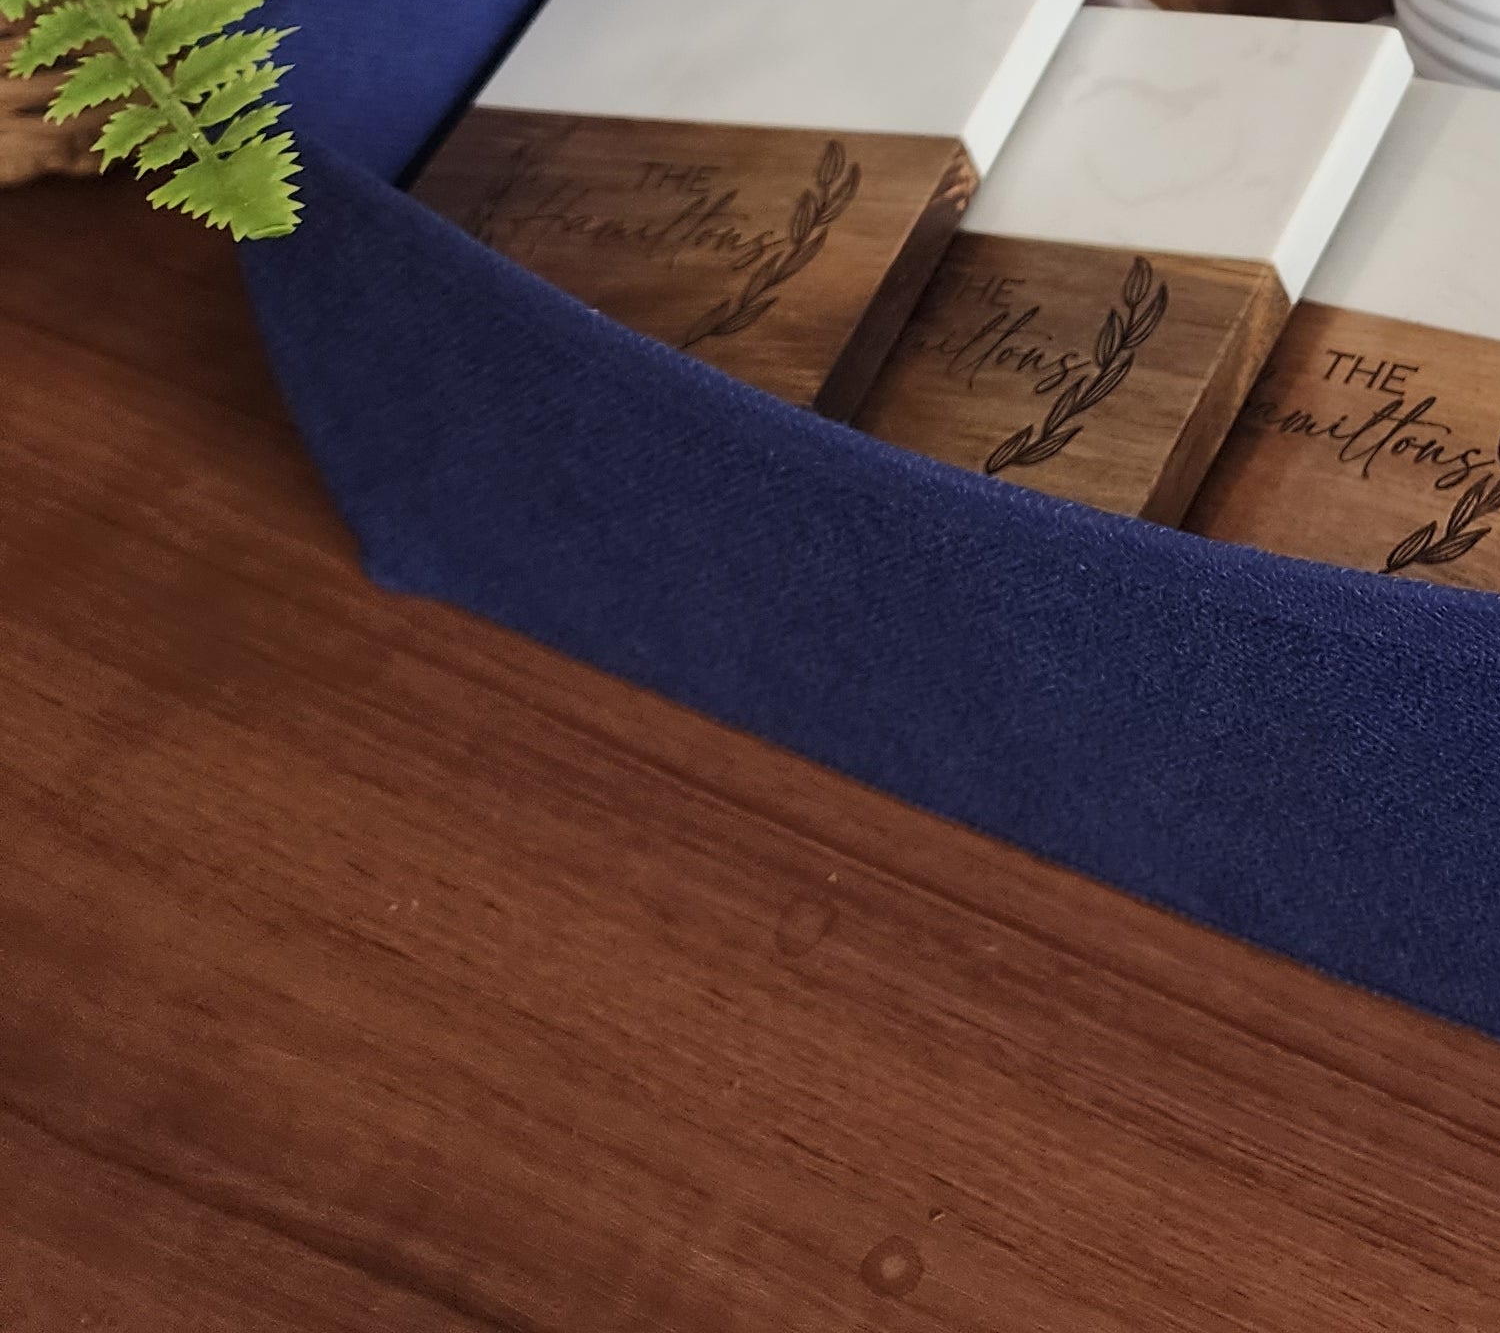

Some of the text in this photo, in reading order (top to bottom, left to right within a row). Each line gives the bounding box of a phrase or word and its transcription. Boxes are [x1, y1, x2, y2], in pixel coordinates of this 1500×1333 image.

[639, 160, 722, 193] THE
[1322, 348, 1420, 397] THE
[1248, 396, 1497, 491] amiltons
